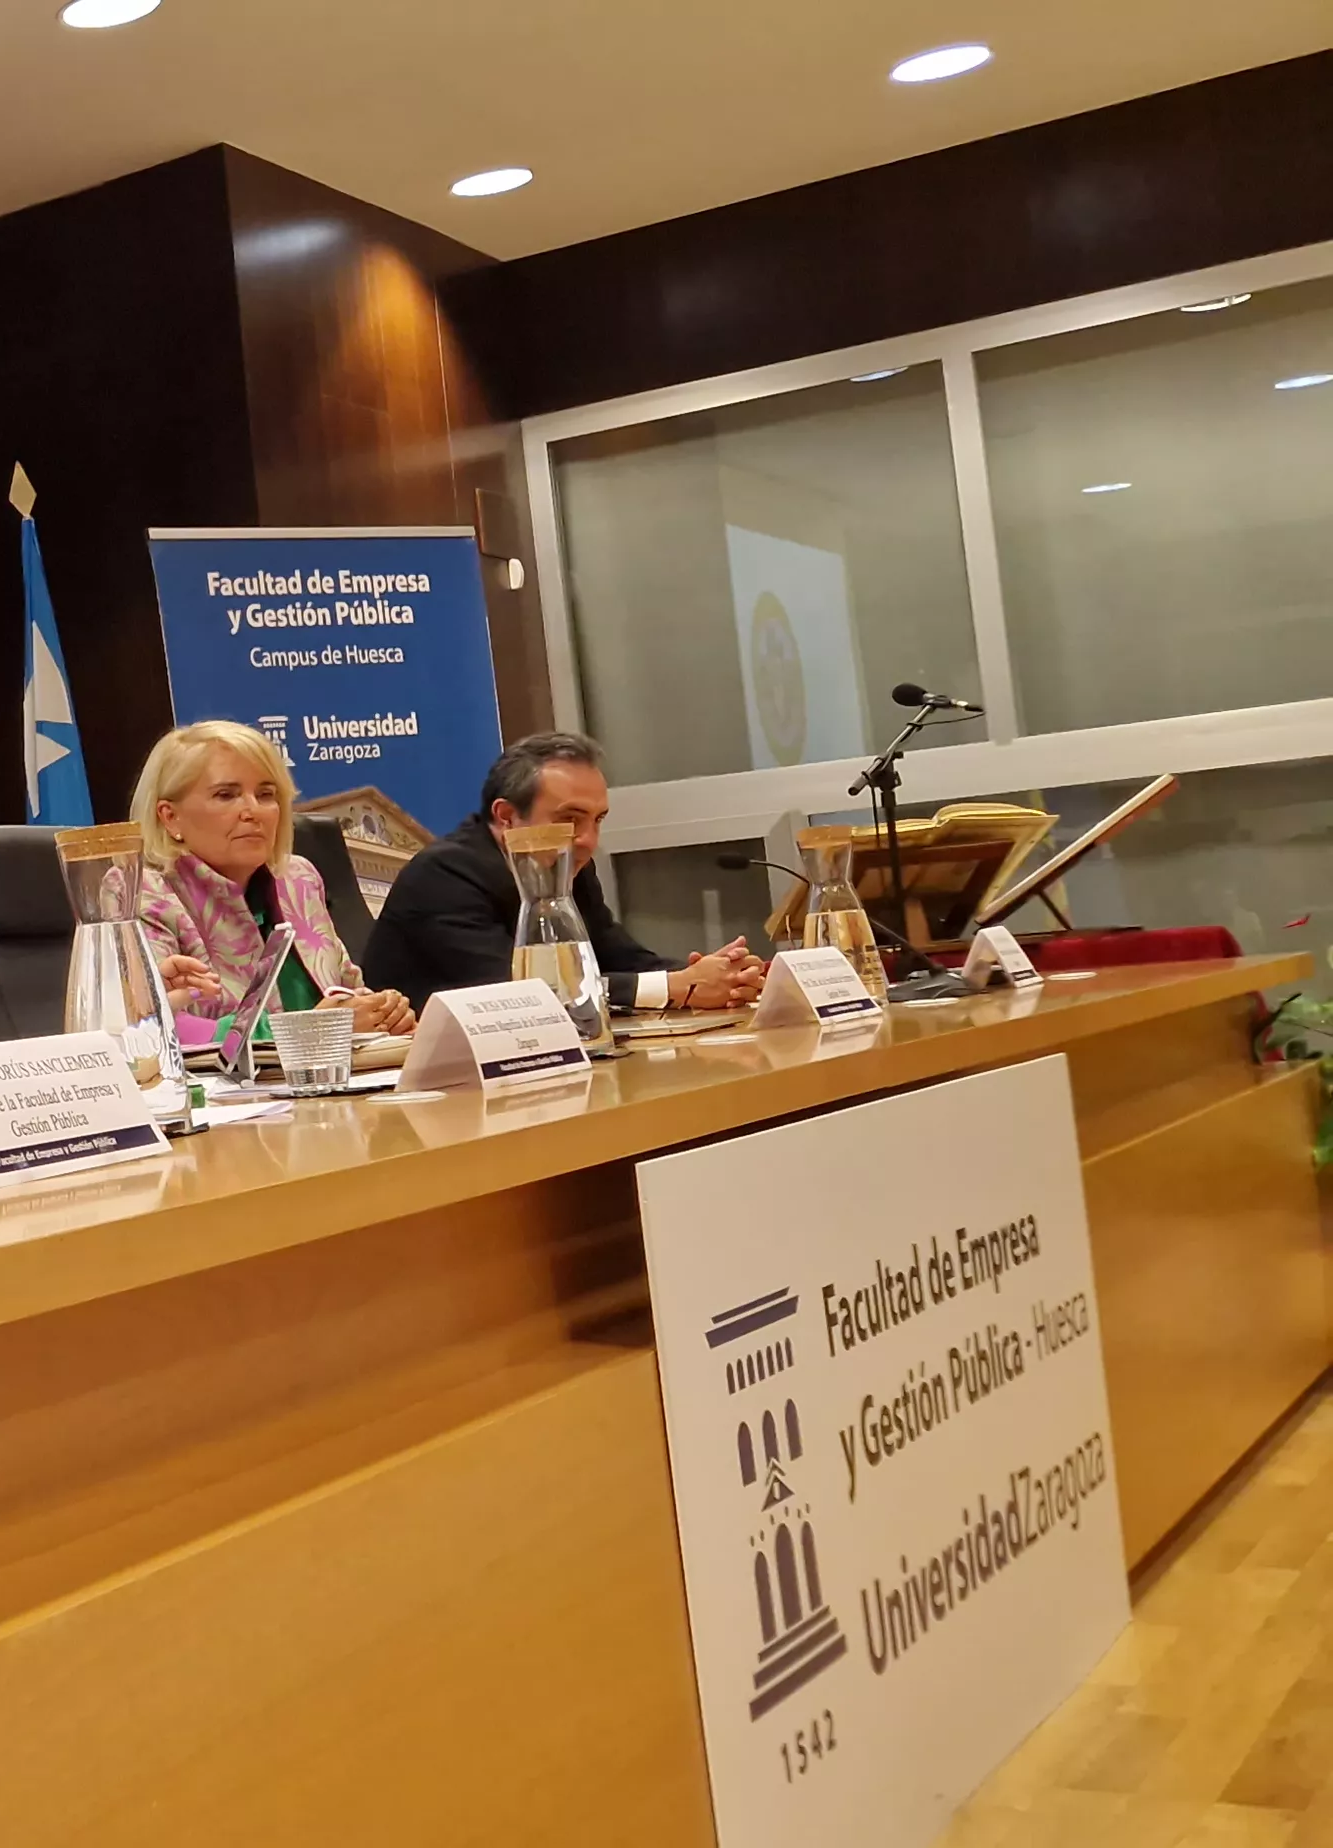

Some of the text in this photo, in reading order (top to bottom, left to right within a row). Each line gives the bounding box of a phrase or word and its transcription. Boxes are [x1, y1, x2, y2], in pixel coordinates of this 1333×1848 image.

[207, 569, 430, 598] Facultad de Empresa
[227, 599, 415, 635] y Gestión Pública
[250, 644, 404, 671] Campus de Huesca
[303, 712, 419, 740] Universidad
[308, 742, 381, 765] Zaragoza
[27, 1051, 113, 1076] SANCLEMENTE
[3, 1094, 16, 1111] la
[15, 1088, 60, 1109] Facultad
[60, 1086, 73, 1102] de
[71, 1084, 113, 1103] Empresa
[112, 1082, 122, 1099] y
[10, 1111, 89, 1137] Gestión Pública
[822, 1214, 1040, 1357] Facultad de Empresa
[839, 1425, 856, 1504] y
[861, 1360, 949, 1467] Gestión
[947, 1323, 1025, 1413] Pública
[1032, 1292, 1089, 1361] Huesca
[780, 1708, 837, 1784] 1542
